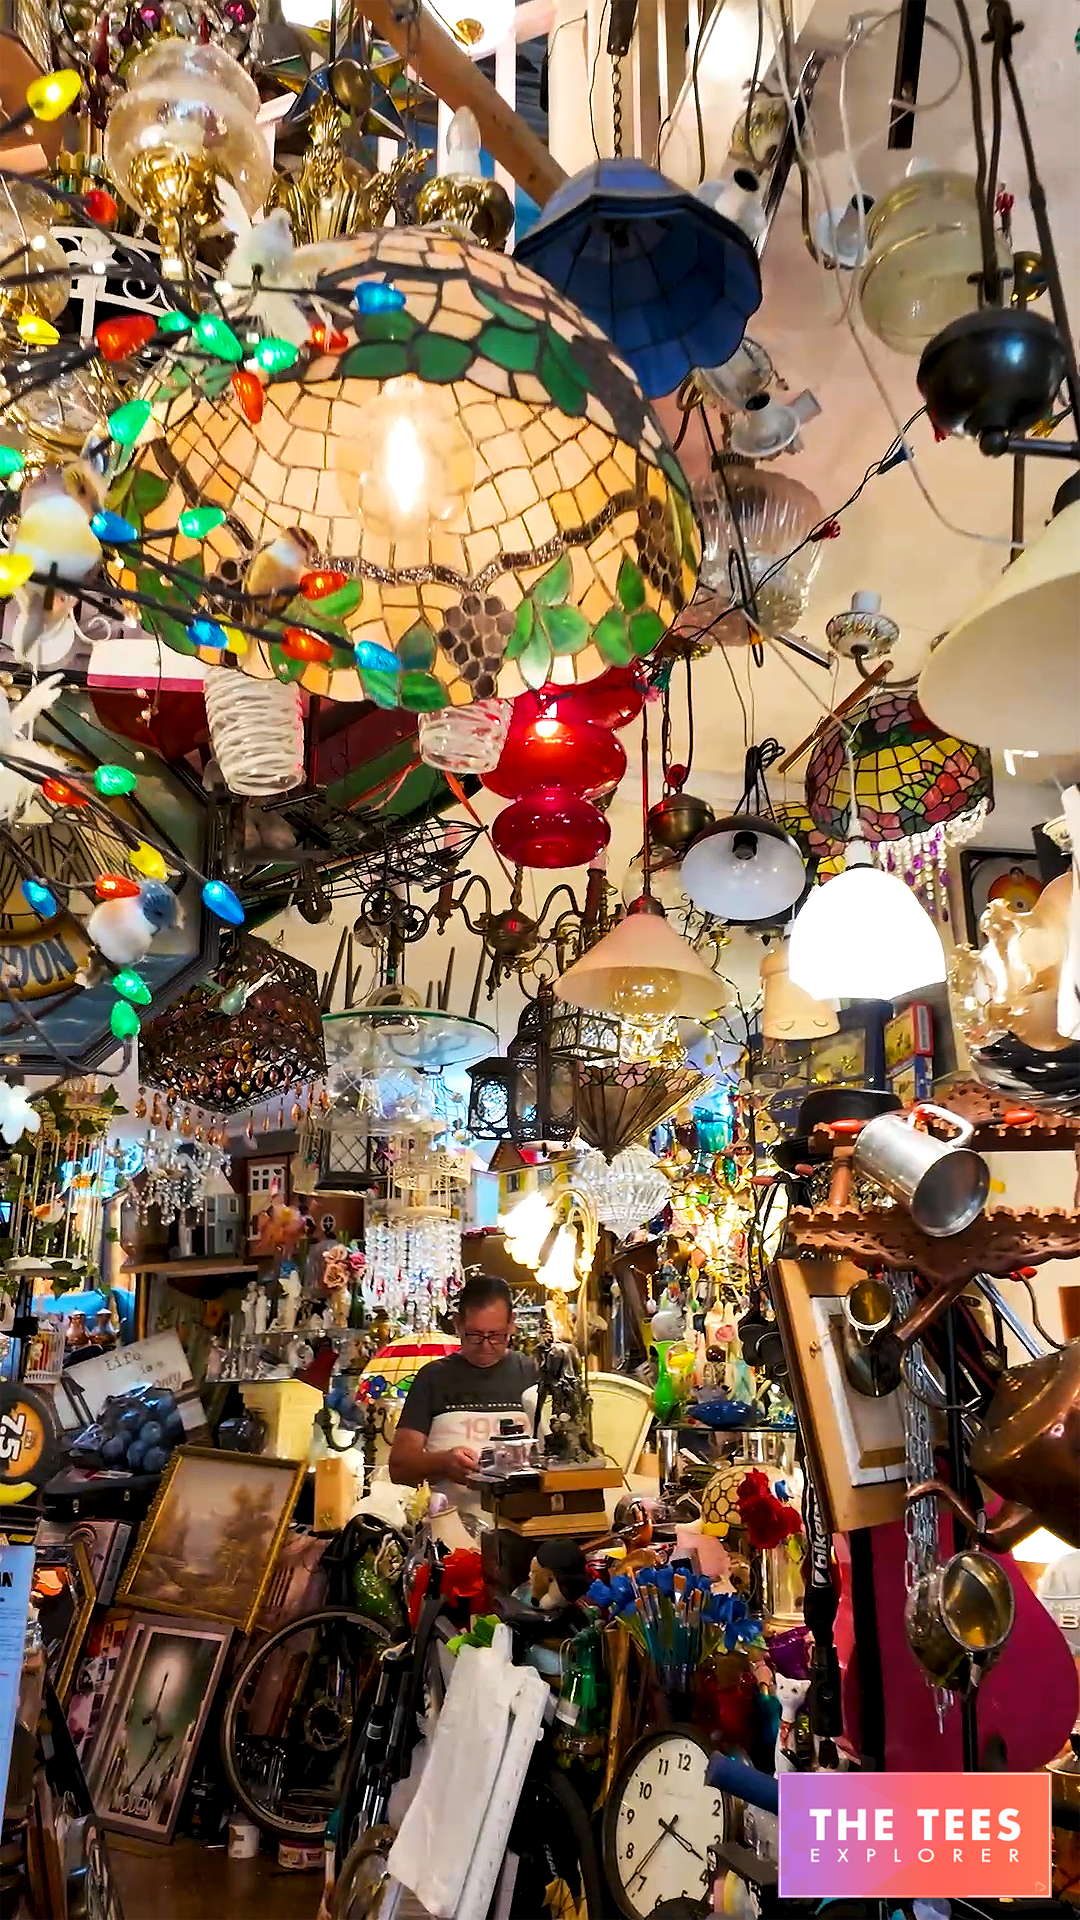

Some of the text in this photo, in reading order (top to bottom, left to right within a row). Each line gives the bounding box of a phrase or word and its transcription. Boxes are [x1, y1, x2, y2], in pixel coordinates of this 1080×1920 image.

[0, 932, 78, 989] DON
[105, 1352, 141, 1371] Life
[658, 1758, 669, 1776] 11
[677, 1753, 692, 1771] 12
[639, 1781, 653, 1800] 10
[626, 1808, 635, 1825] 9
[712, 1799, 721, 1816] 2
[626, 1842, 635, 1859] 8
[637, 1874, 647, 1892] 7
